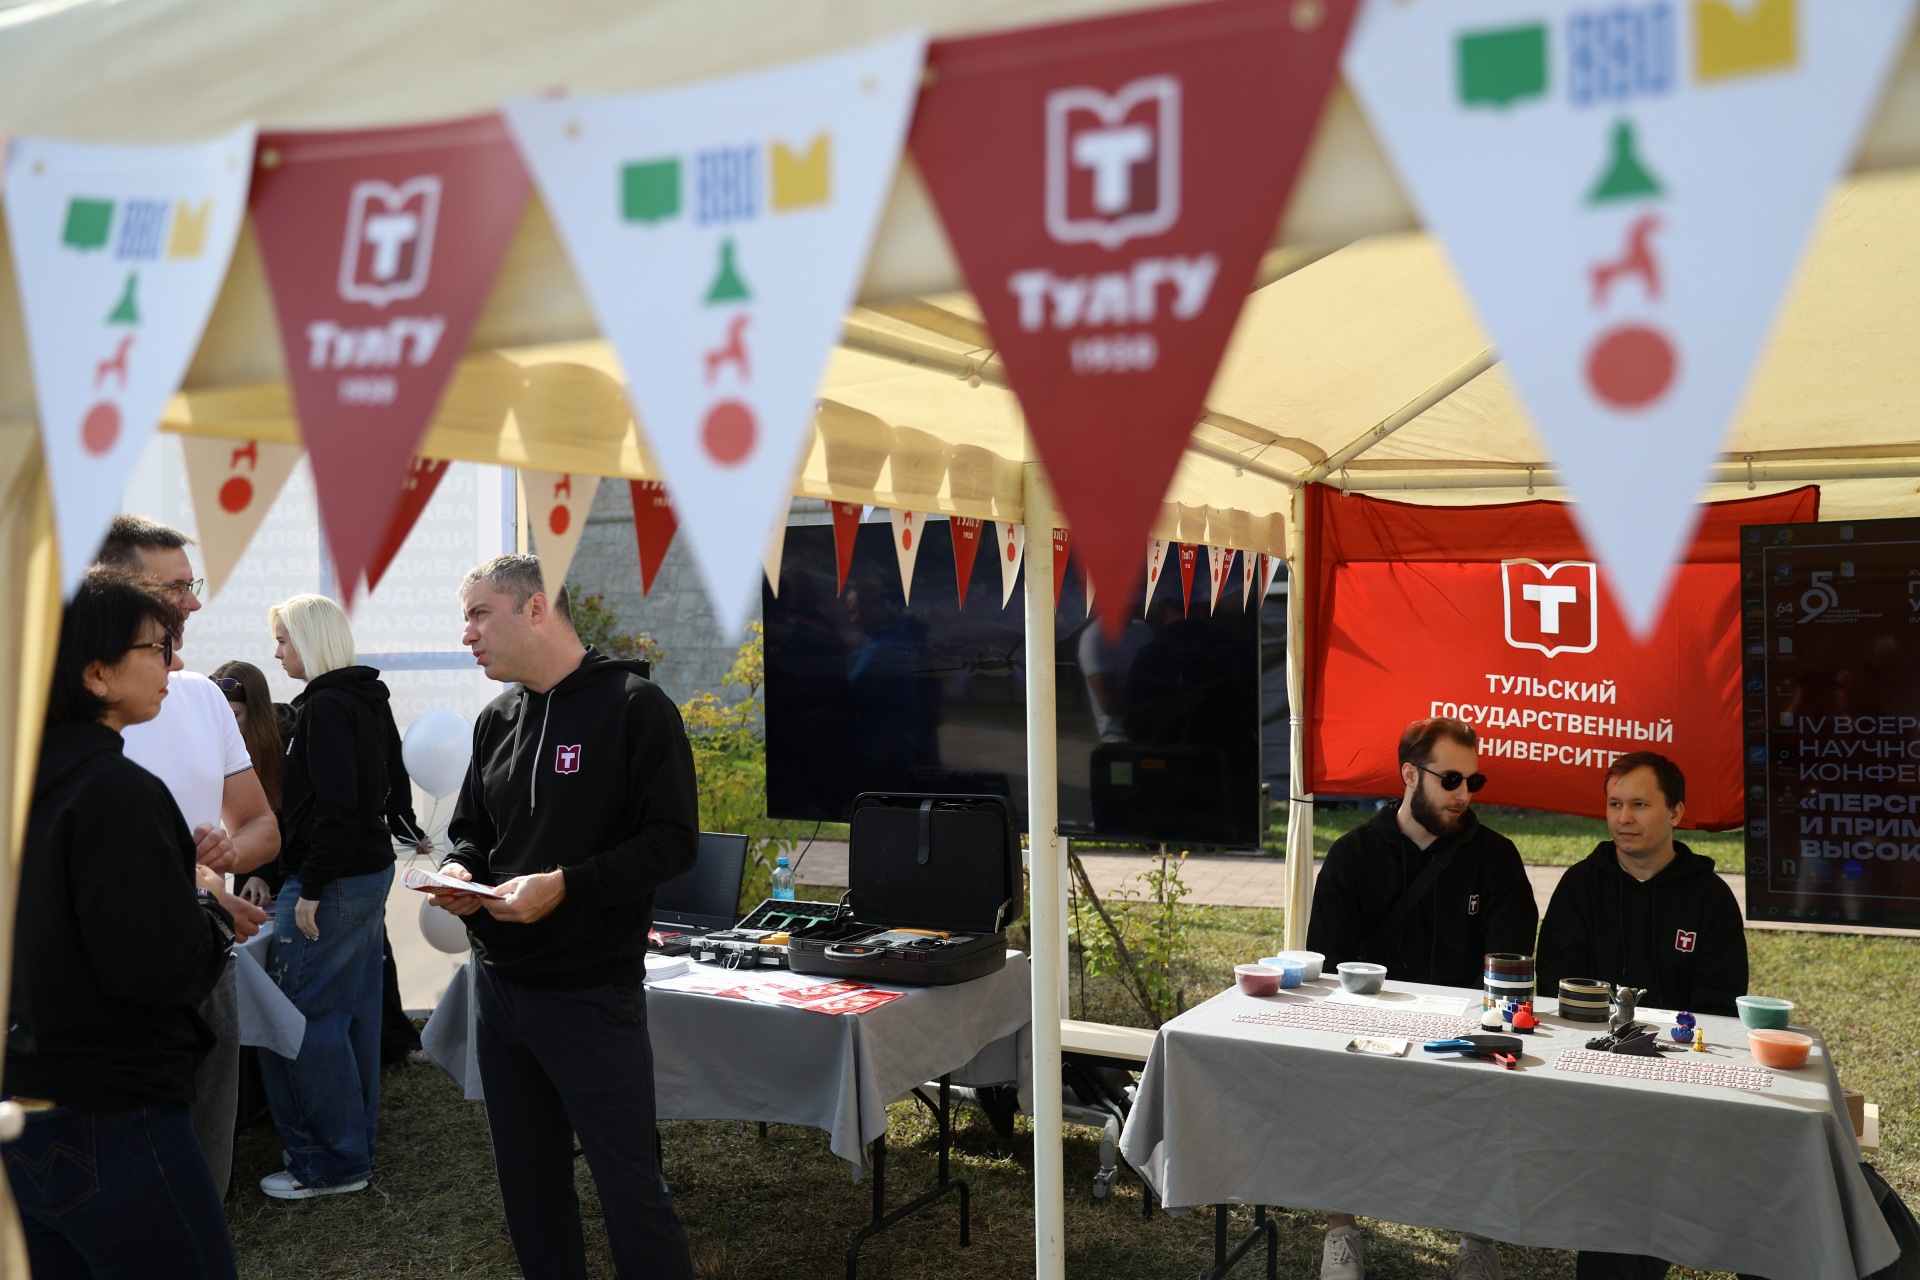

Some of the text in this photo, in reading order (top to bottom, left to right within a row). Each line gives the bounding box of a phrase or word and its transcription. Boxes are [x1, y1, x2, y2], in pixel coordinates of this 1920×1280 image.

[1485, 673, 1617, 705] ТУЛЬСКИЙ
[1430, 700, 1674, 744] ГОСУДАРСТВЕННЫЙ
[1799, 715, 1920, 735] IV ВСЕР
[1477, 736, 1630, 769] НИВЕРСИТЕ
[1799, 763, 1920, 783] КОНФЕ
[1800, 815, 1824, 835] И
